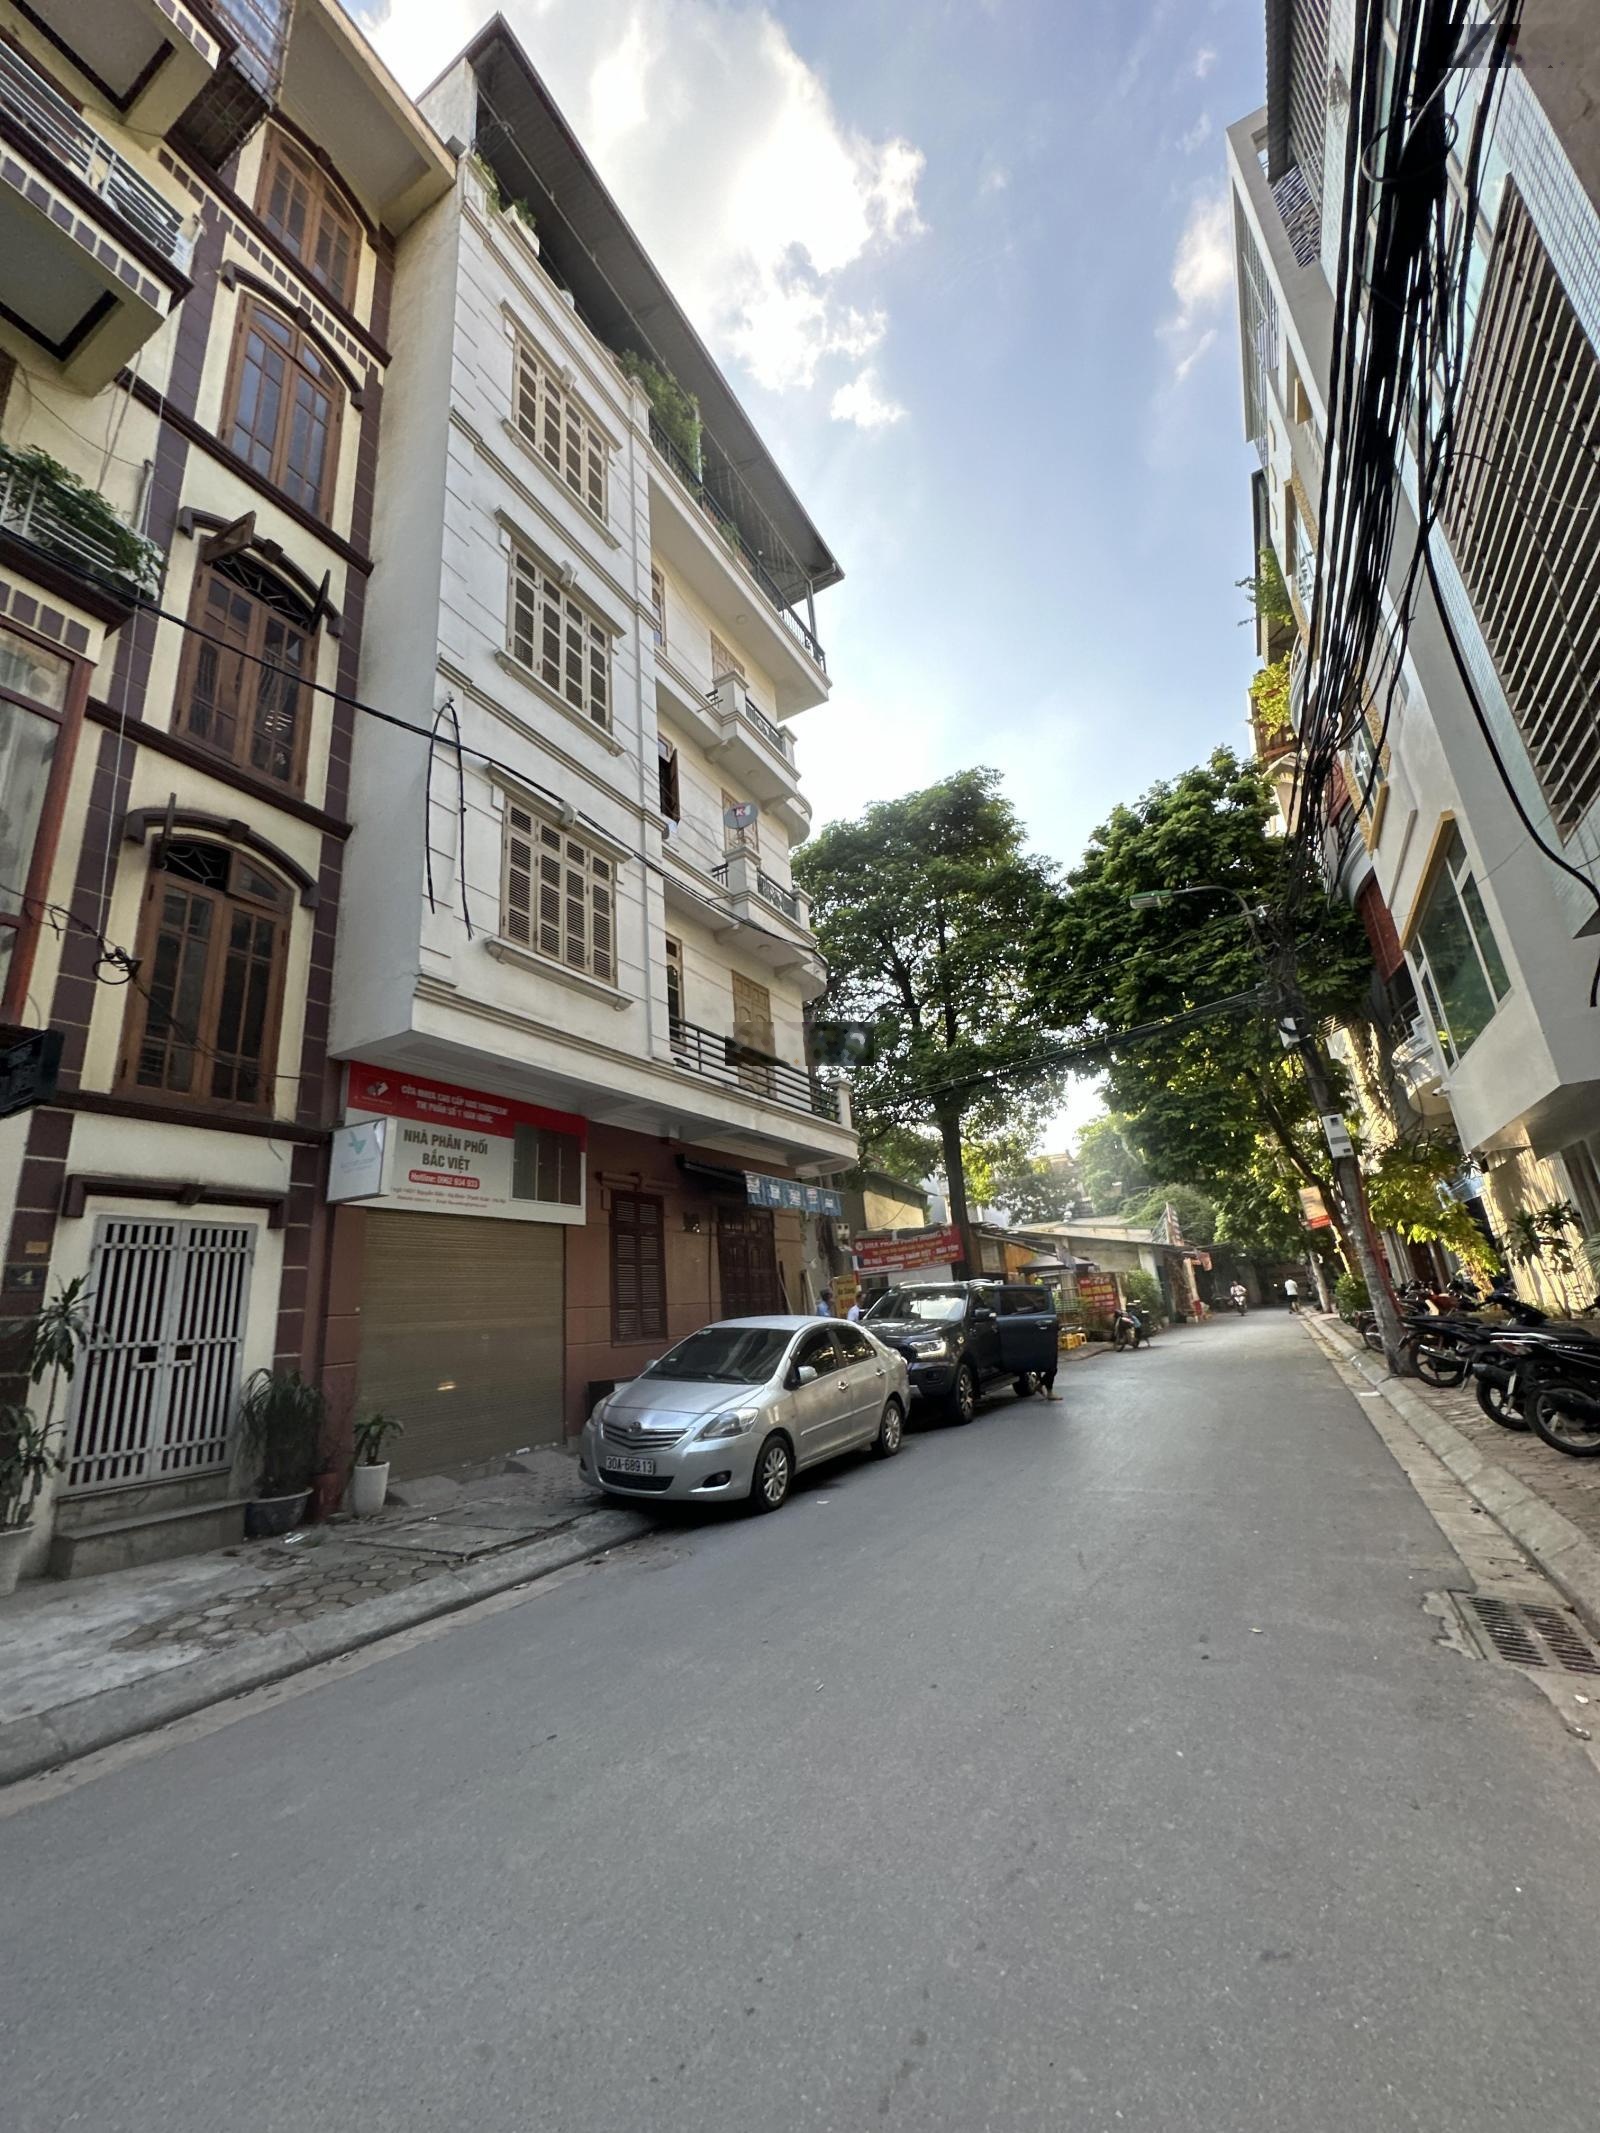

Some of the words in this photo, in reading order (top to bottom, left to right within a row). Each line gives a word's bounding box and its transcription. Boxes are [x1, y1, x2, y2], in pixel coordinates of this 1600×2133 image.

[403, 1129, 428, 1145] NHÀ
[431, 1134, 461, 1150] PHÂN
[463, 1138, 488, 1155] PHỐI
[422, 1149, 445, 1168] BẮC
[447, 1156, 470, 1174] VIỆT
[17, 1270, 33, 1285] 4
[607, 1456, 652, 1473] 30A-689.13
